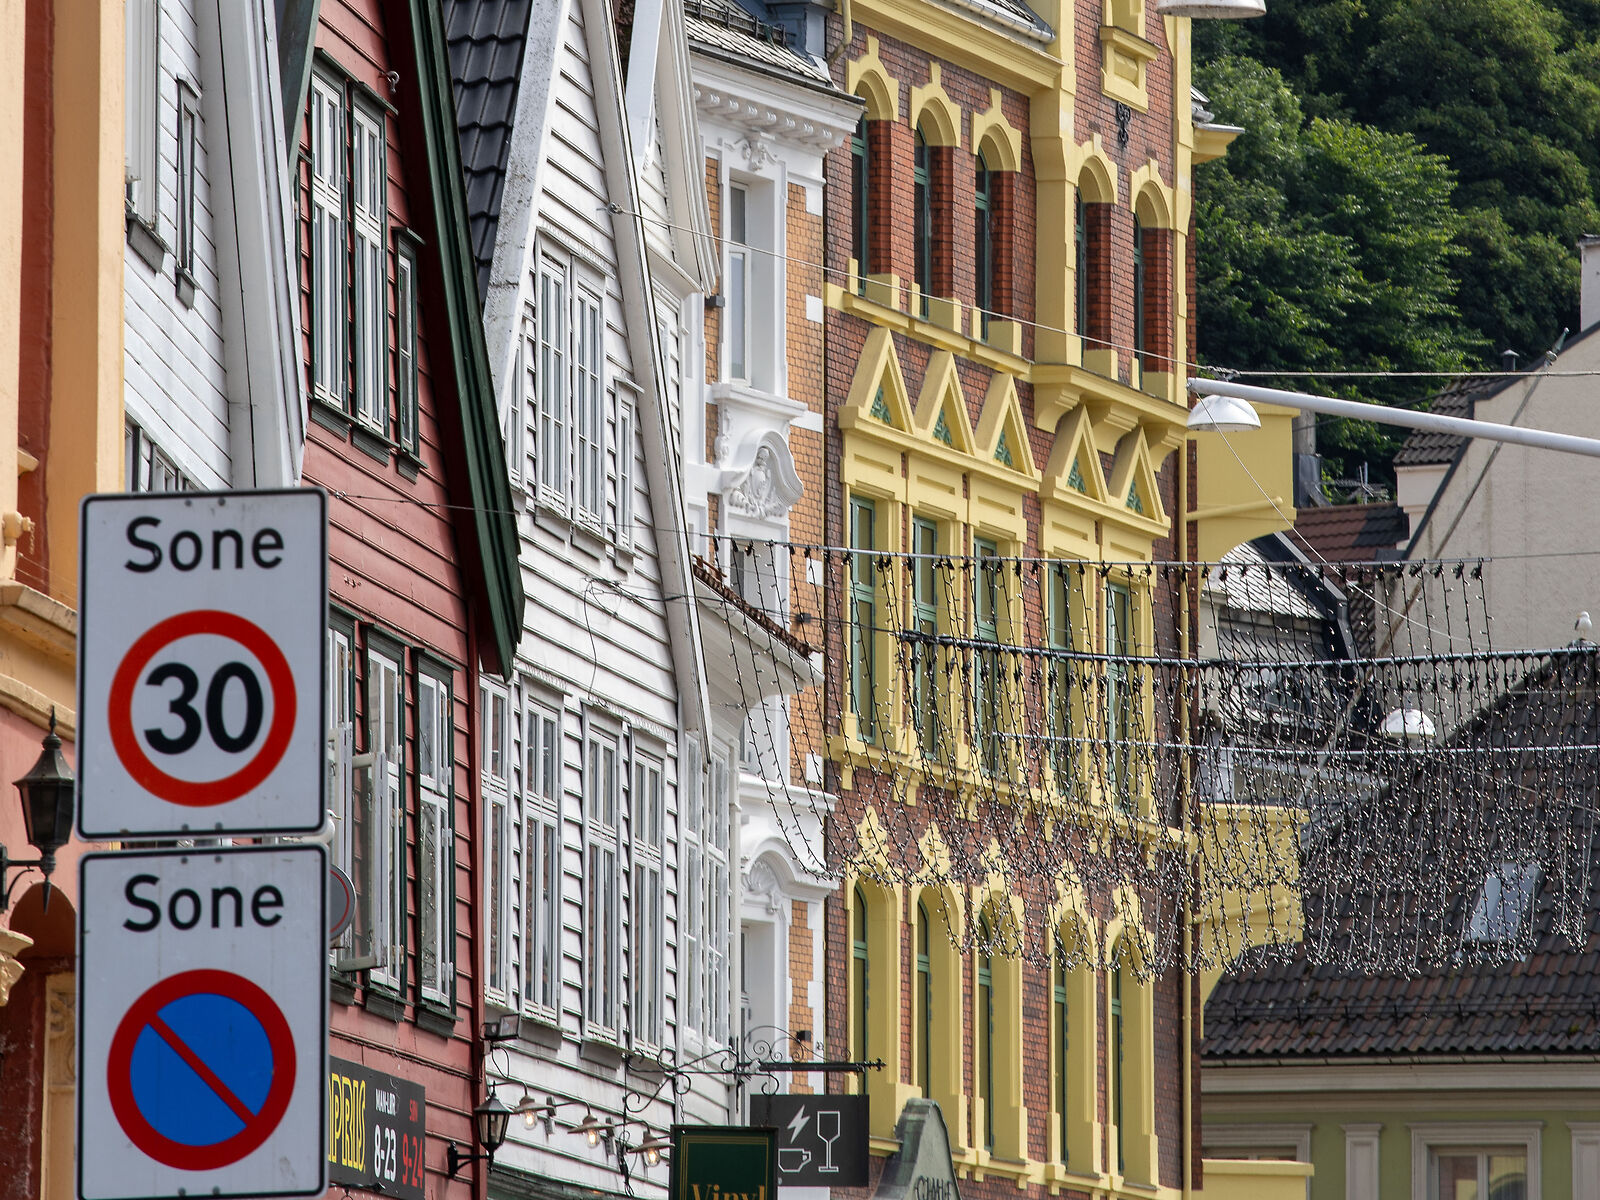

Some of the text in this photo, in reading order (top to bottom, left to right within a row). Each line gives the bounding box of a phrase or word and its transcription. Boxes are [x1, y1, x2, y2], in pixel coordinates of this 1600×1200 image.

[125, 516, 284, 573] Sone
[145, 662, 263, 755] 30
[123, 873, 284, 933] Sone
[375, 1125, 397, 1182] 8-23
[402, 1133, 424, 1189] 9-24
